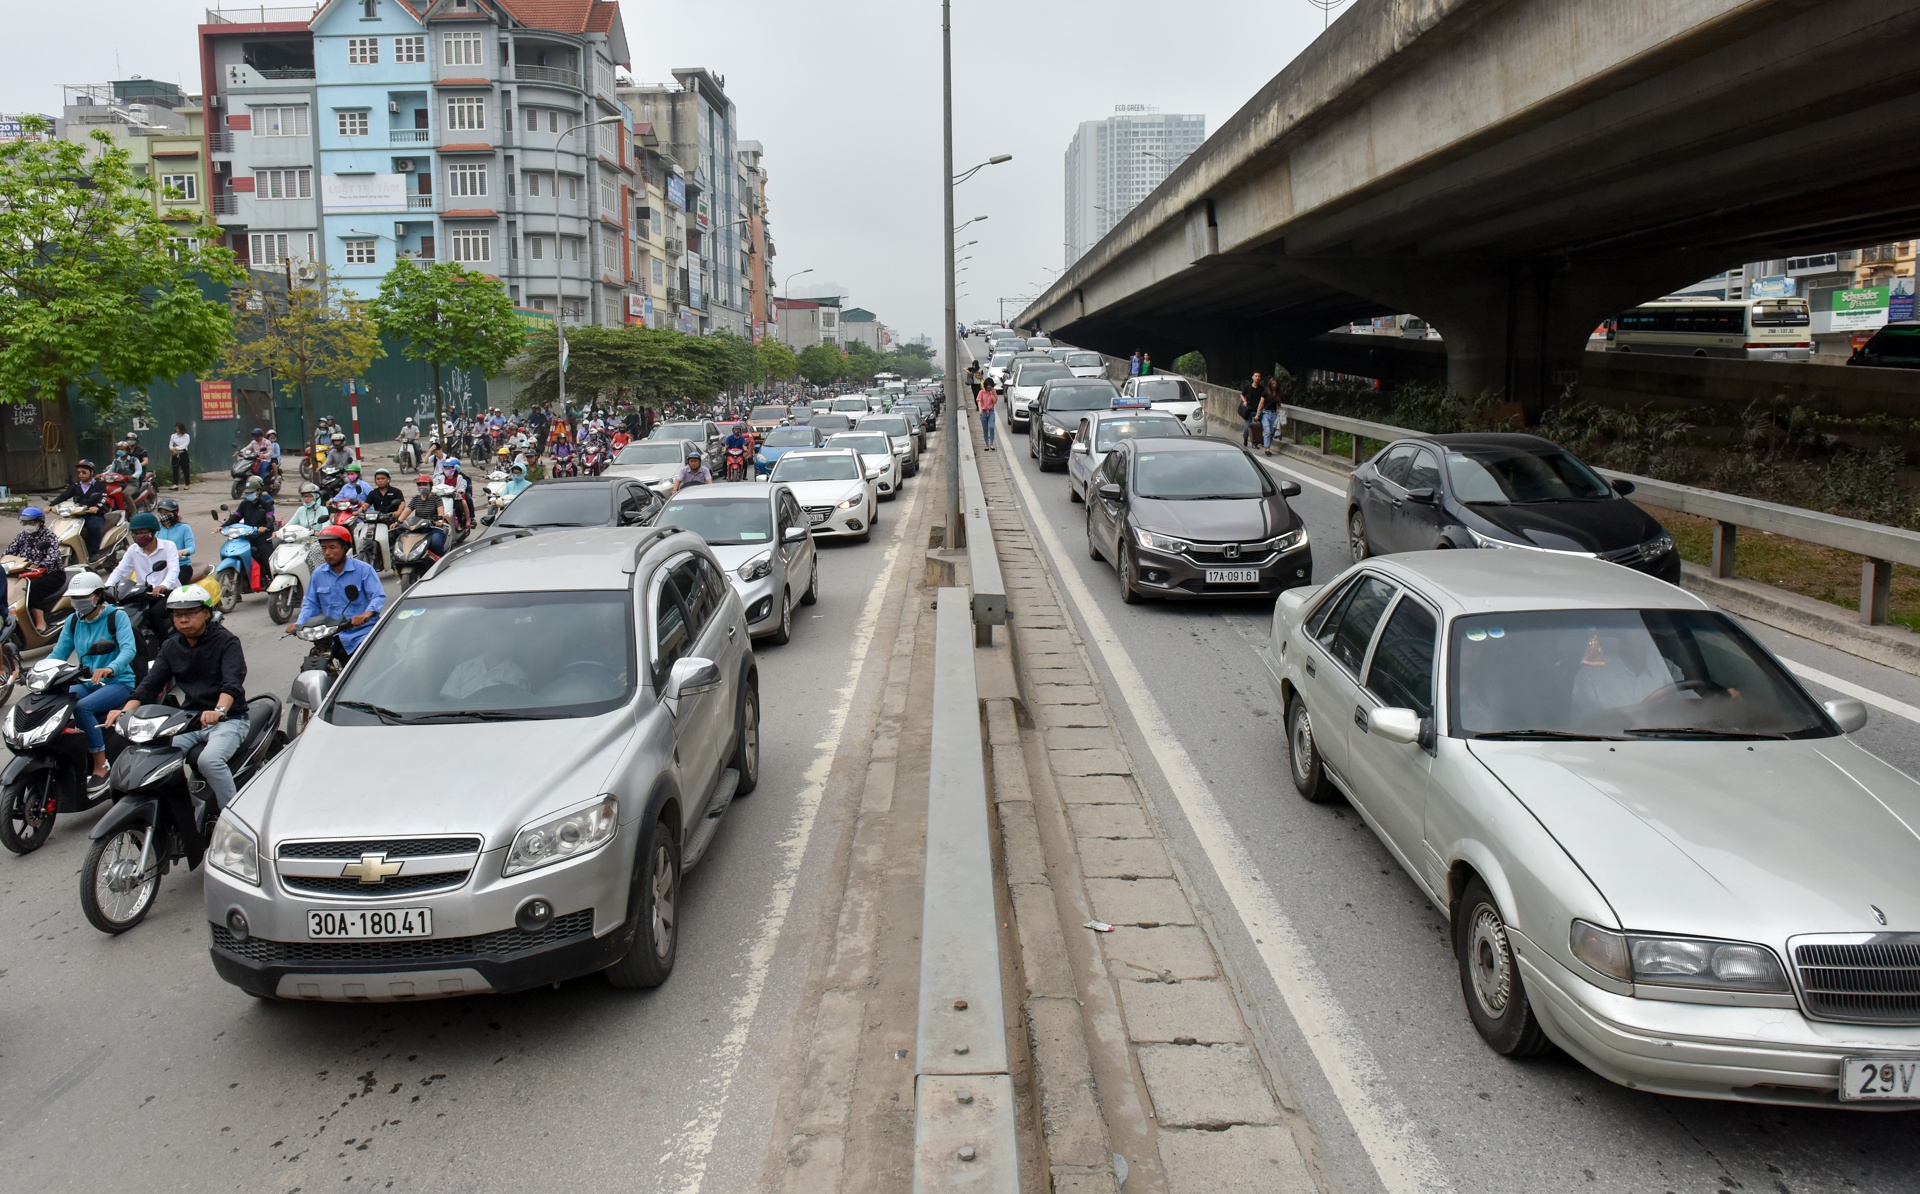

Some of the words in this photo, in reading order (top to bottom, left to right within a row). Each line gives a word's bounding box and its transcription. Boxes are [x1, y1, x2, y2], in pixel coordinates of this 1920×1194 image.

[1115, 104, 1126, 112] ECO
[1127, 104, 1145, 112] GREEN
[1842, 290, 1879, 302] Schneider
[1209, 571, 1257, 582] 17A-091.61
[311, 911, 426, 936] 30A-180.41
